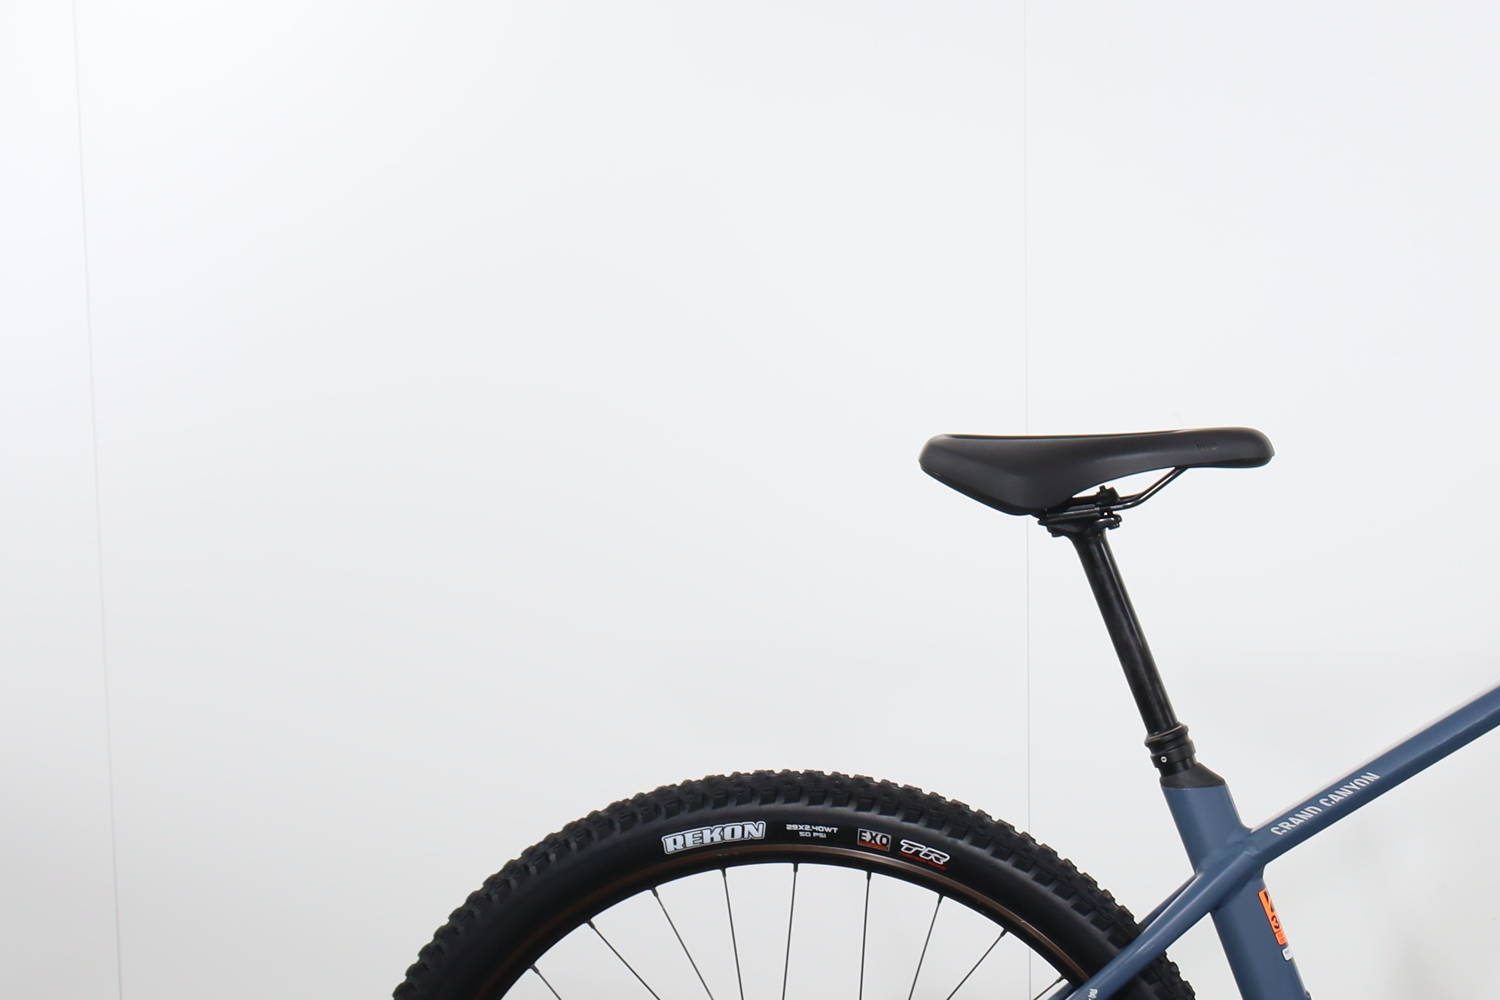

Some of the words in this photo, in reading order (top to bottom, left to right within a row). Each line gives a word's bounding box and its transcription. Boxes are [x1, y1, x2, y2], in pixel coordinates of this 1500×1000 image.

[1319, 771, 1380, 807] CANYON
[661, 820, 767, 855] REKON
[857, 829, 891, 849] EXO
[900, 839, 950, 865] TR
